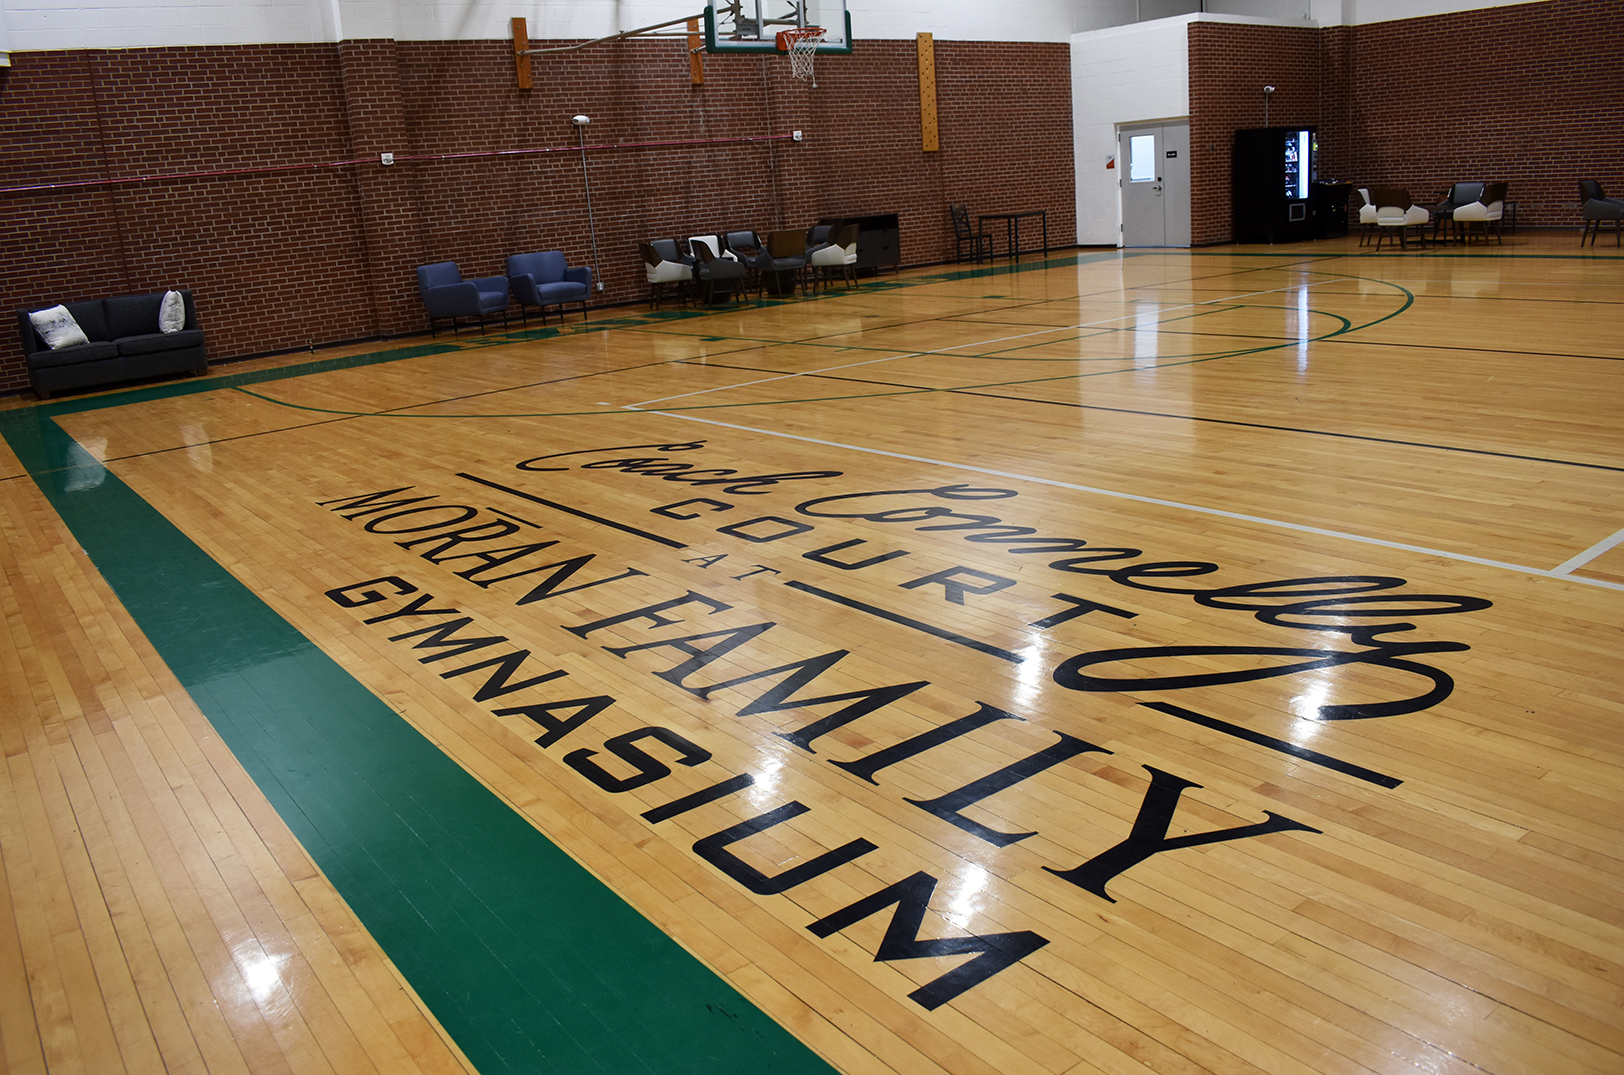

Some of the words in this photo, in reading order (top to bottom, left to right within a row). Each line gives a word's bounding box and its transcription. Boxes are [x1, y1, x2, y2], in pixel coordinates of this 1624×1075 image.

[315, 485, 650, 607] MORAN
[560, 589, 1323, 904] FAMILY
[515, 440, 844, 495] Coach
[794, 483, 1494, 721] Connelly
[650, 498, 1139, 630] COURT
[681, 552, 782, 581] AT
[324, 575, 1051, 1012] GYMNASIUM
